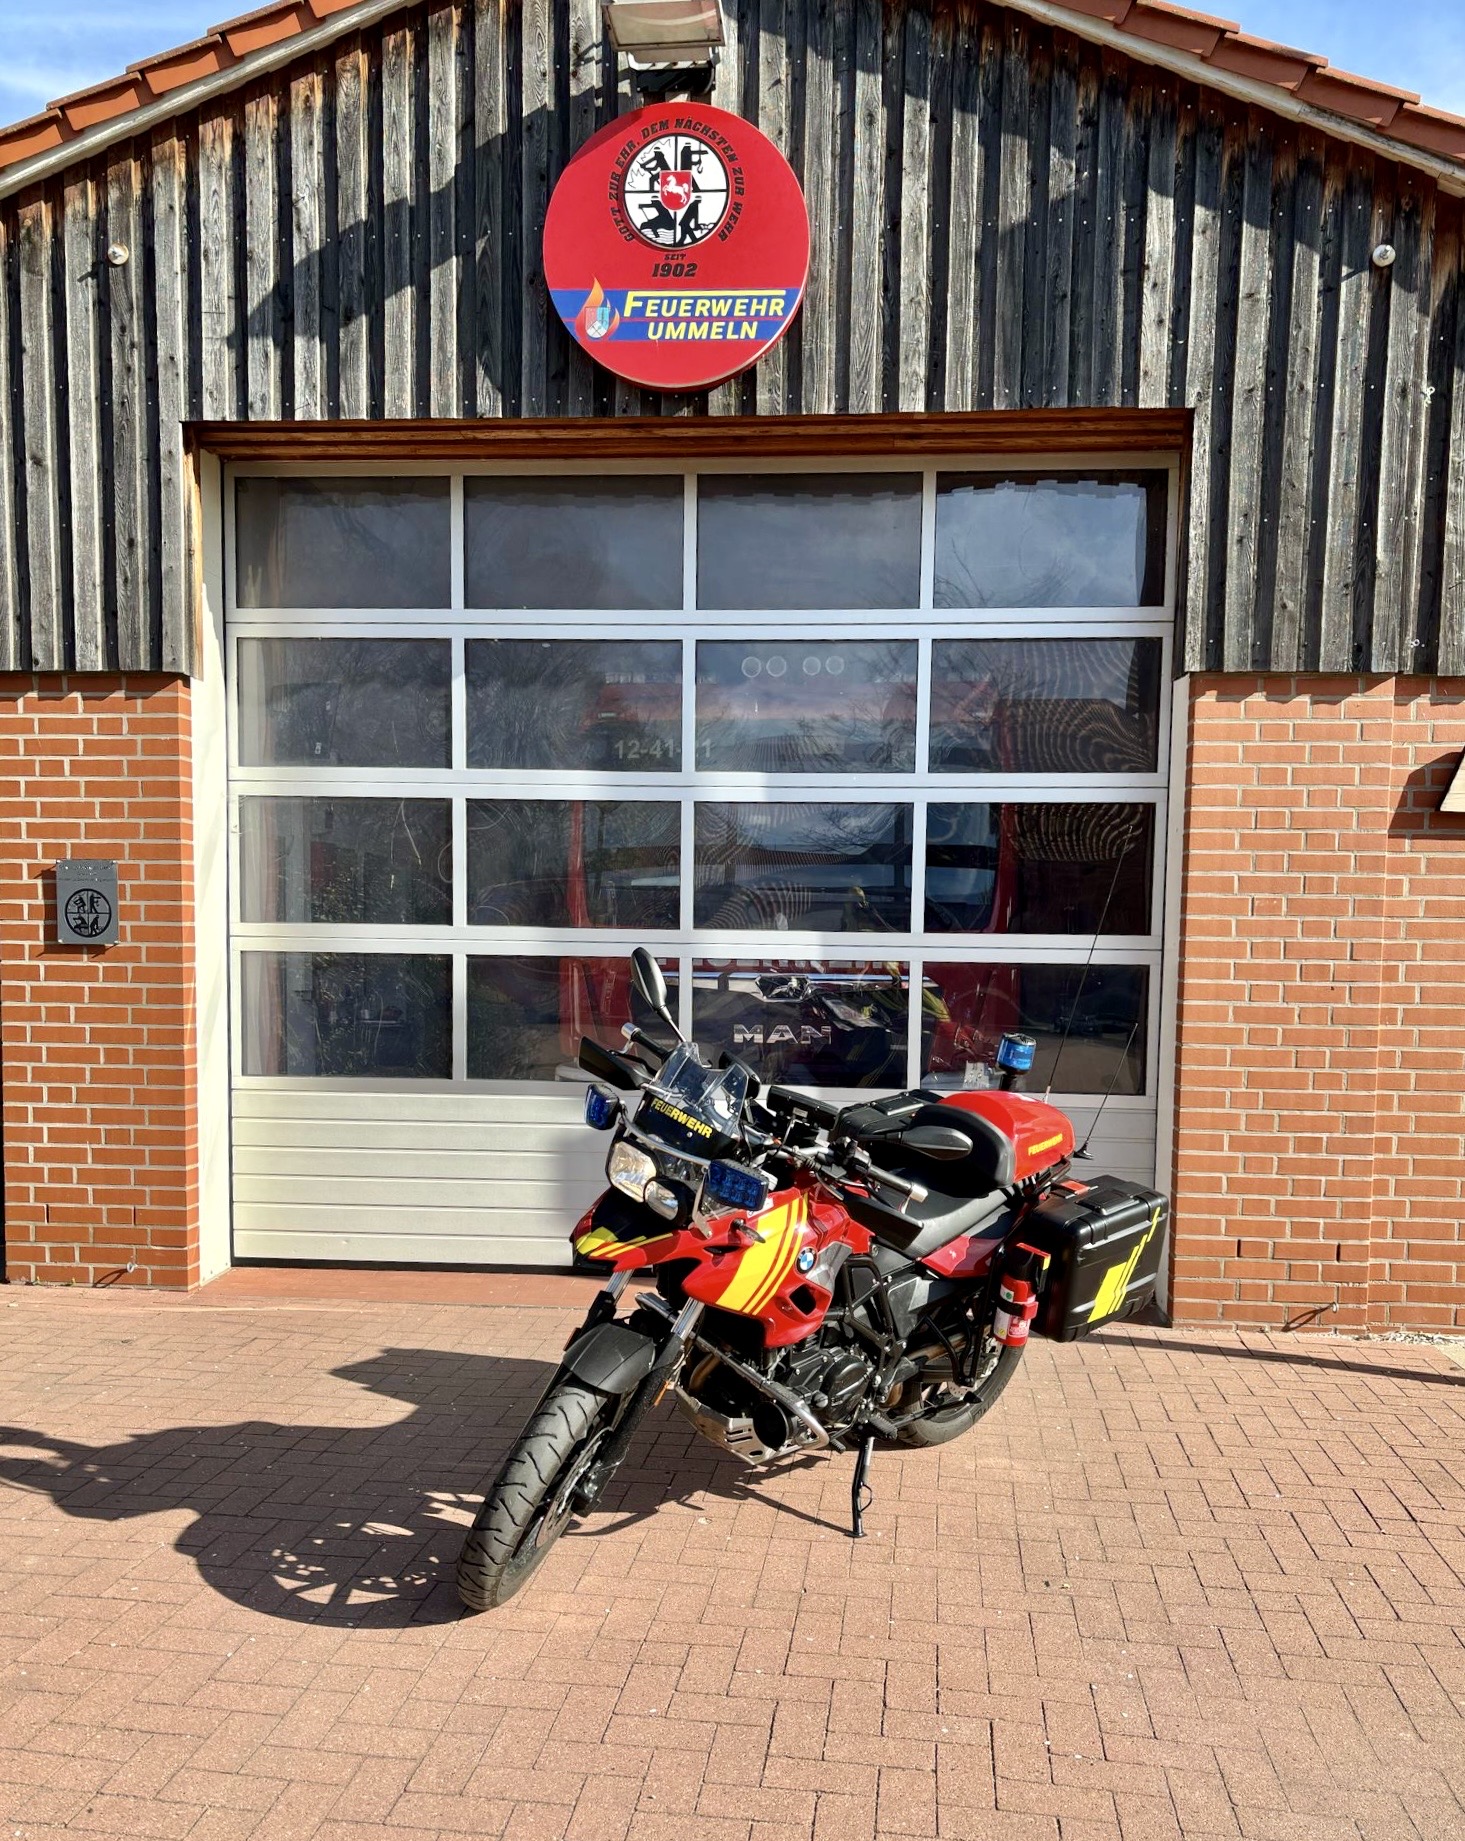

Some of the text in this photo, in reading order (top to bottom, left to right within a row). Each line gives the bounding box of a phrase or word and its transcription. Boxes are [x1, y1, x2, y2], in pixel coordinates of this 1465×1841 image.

[640, 118, 670, 140] DEM
[608, 171, 621, 202] ZUR
[732, 166, 745, 197] ZUR
[610, 206, 636, 242] GOTT
[717, 201, 744, 242] WEHR
[664, 253, 687, 261] SEIT
[652, 262, 698, 278] 1902
[623, 289, 786, 318] FEUERWEHR
[647, 320, 759, 340] UMMELN
[614, 738, 712, 759] 12-41-1
[733, 1023, 832, 1045] MAN
[650, 1097, 713, 1139] FEUERWEHR
[1027, 1132, 1064, 1157] FEUERWEHR
